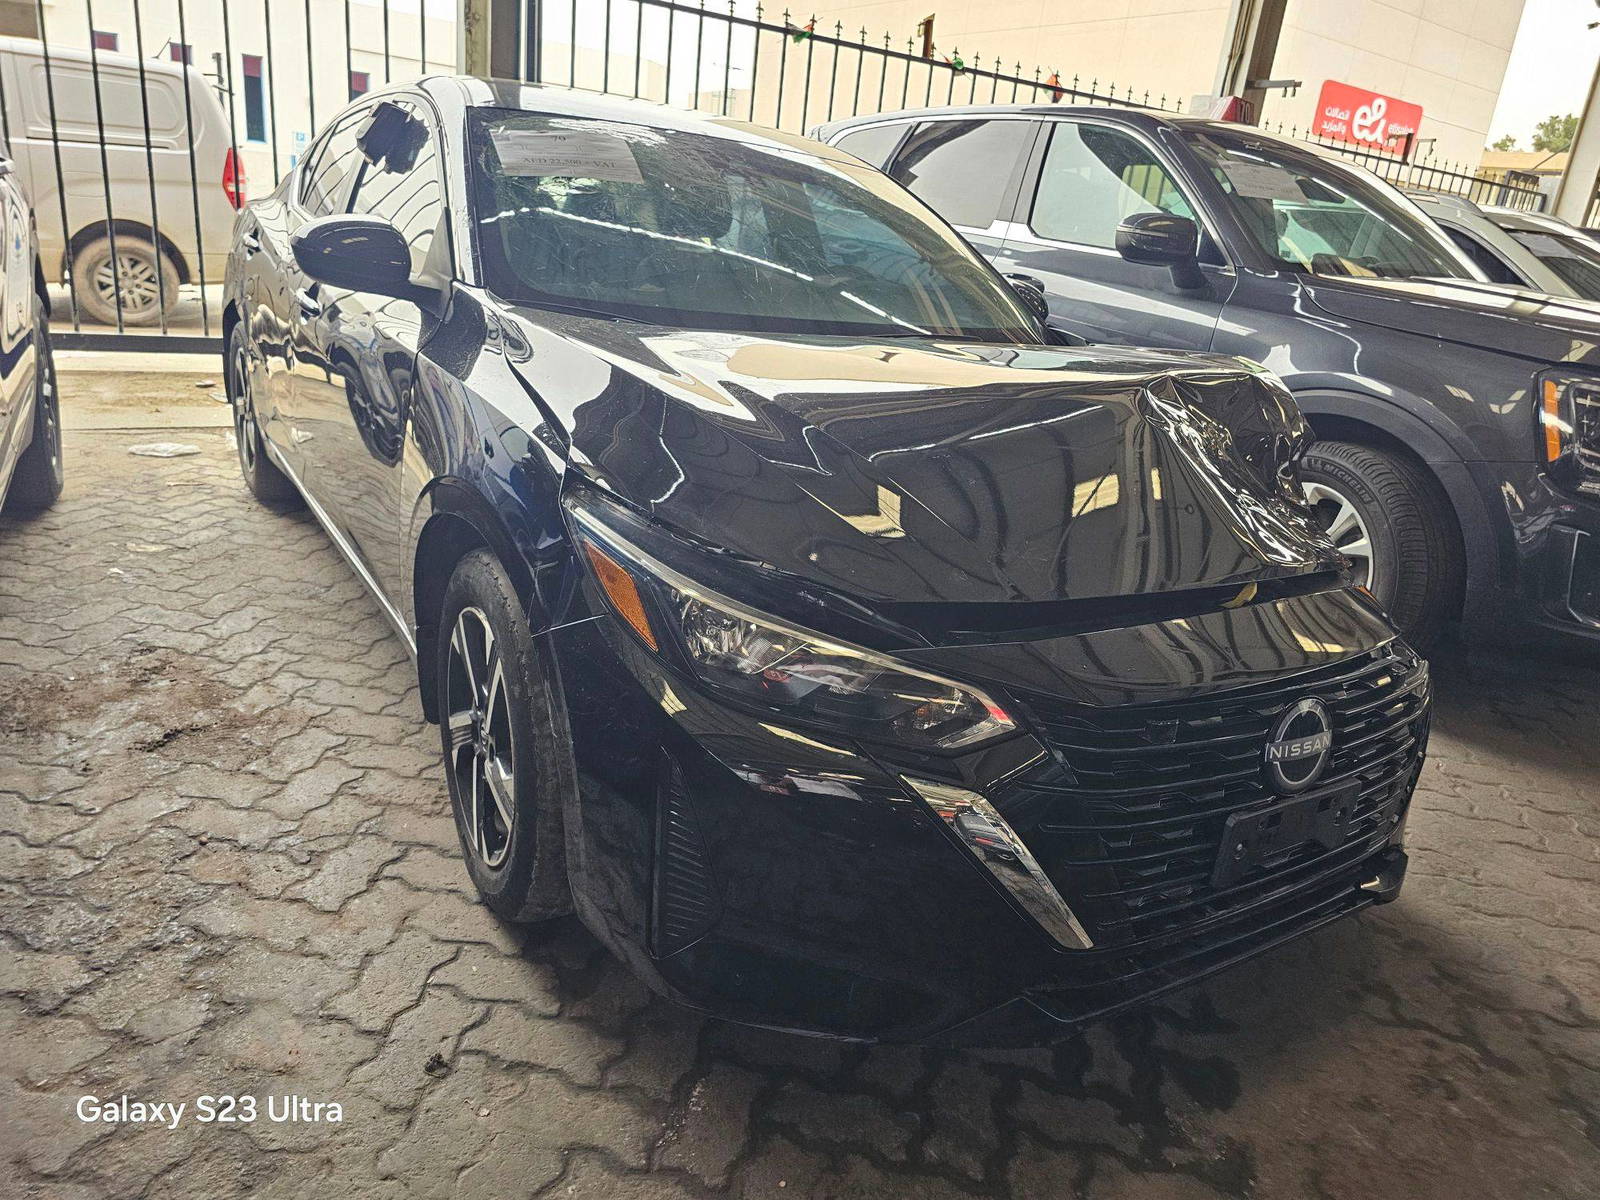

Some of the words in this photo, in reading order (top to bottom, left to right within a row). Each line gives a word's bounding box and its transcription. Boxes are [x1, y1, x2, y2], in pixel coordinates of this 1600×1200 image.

[592, 160, 617, 169] VAT
[1323, 464, 1372, 503] MICHELIN
[1270, 736, 1330, 759] NISSAN
